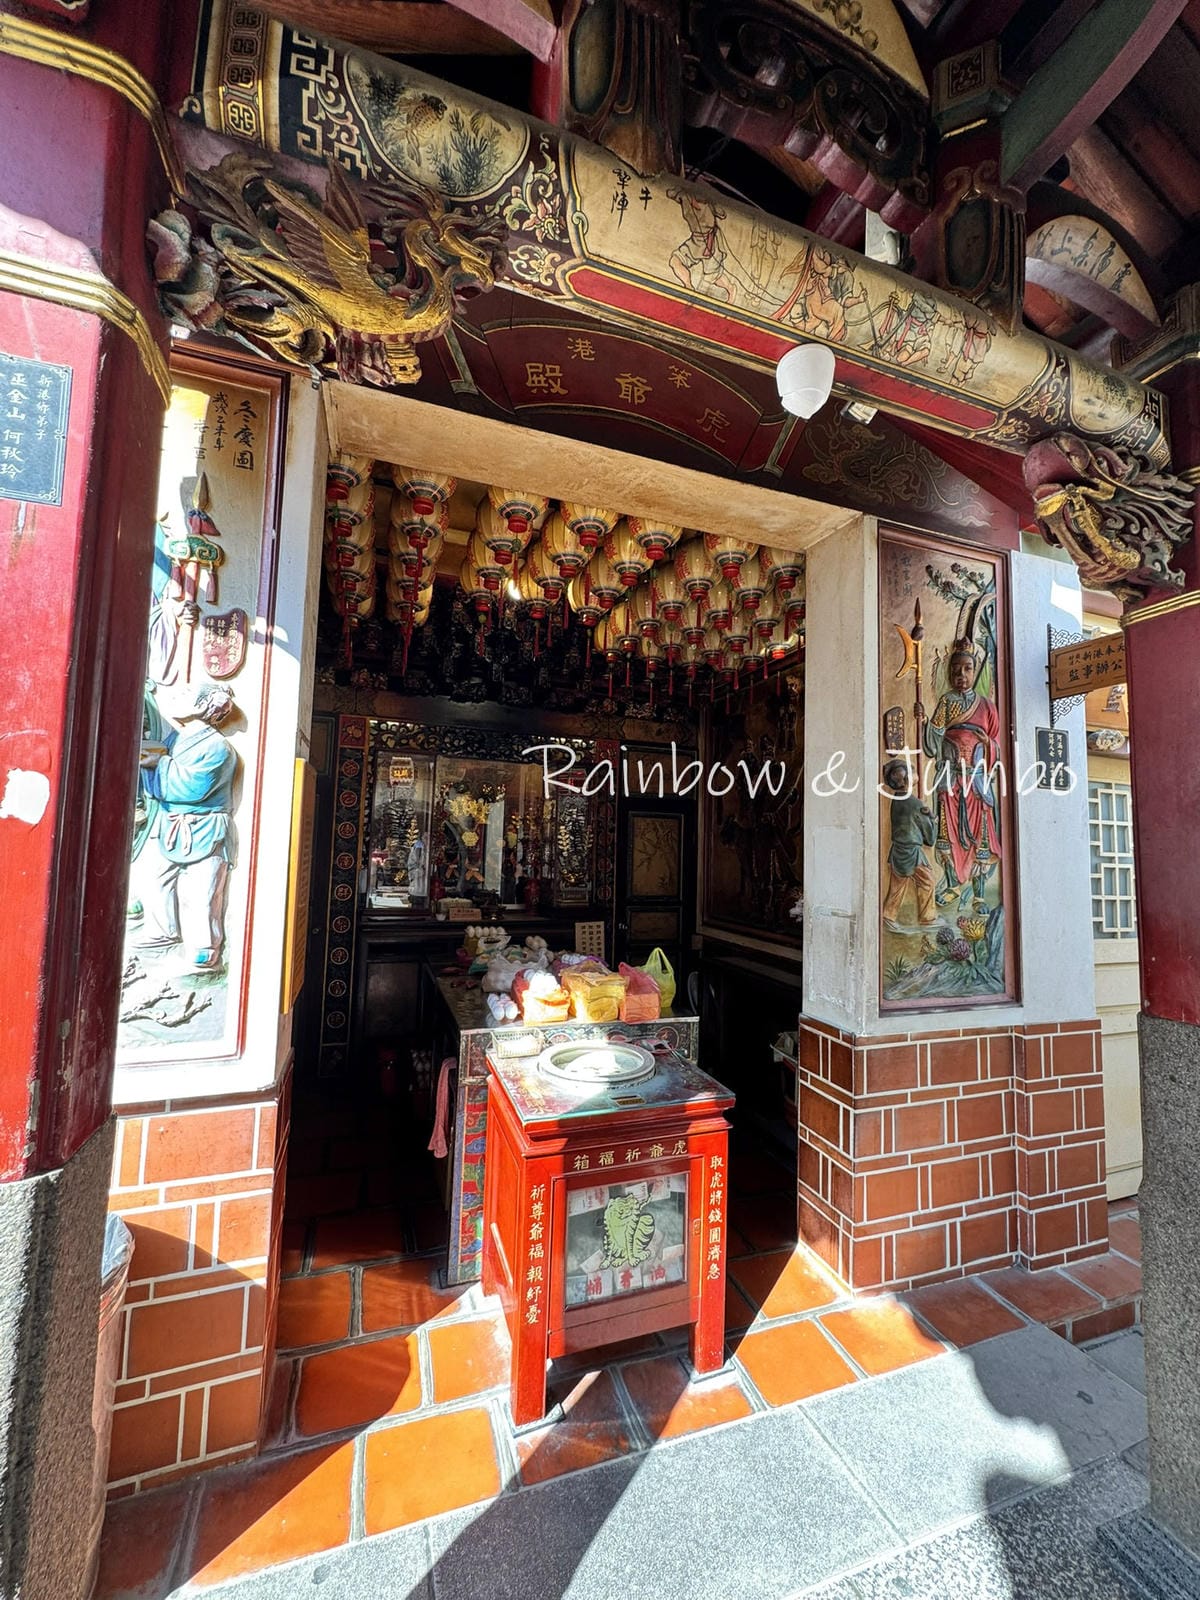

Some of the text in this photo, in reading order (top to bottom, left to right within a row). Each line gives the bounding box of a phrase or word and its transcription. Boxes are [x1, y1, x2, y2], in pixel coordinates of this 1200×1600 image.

[525, 362, 731, 444] 虎爺殿
[574, 1140, 688, 1170] 虎爺祈福箱
